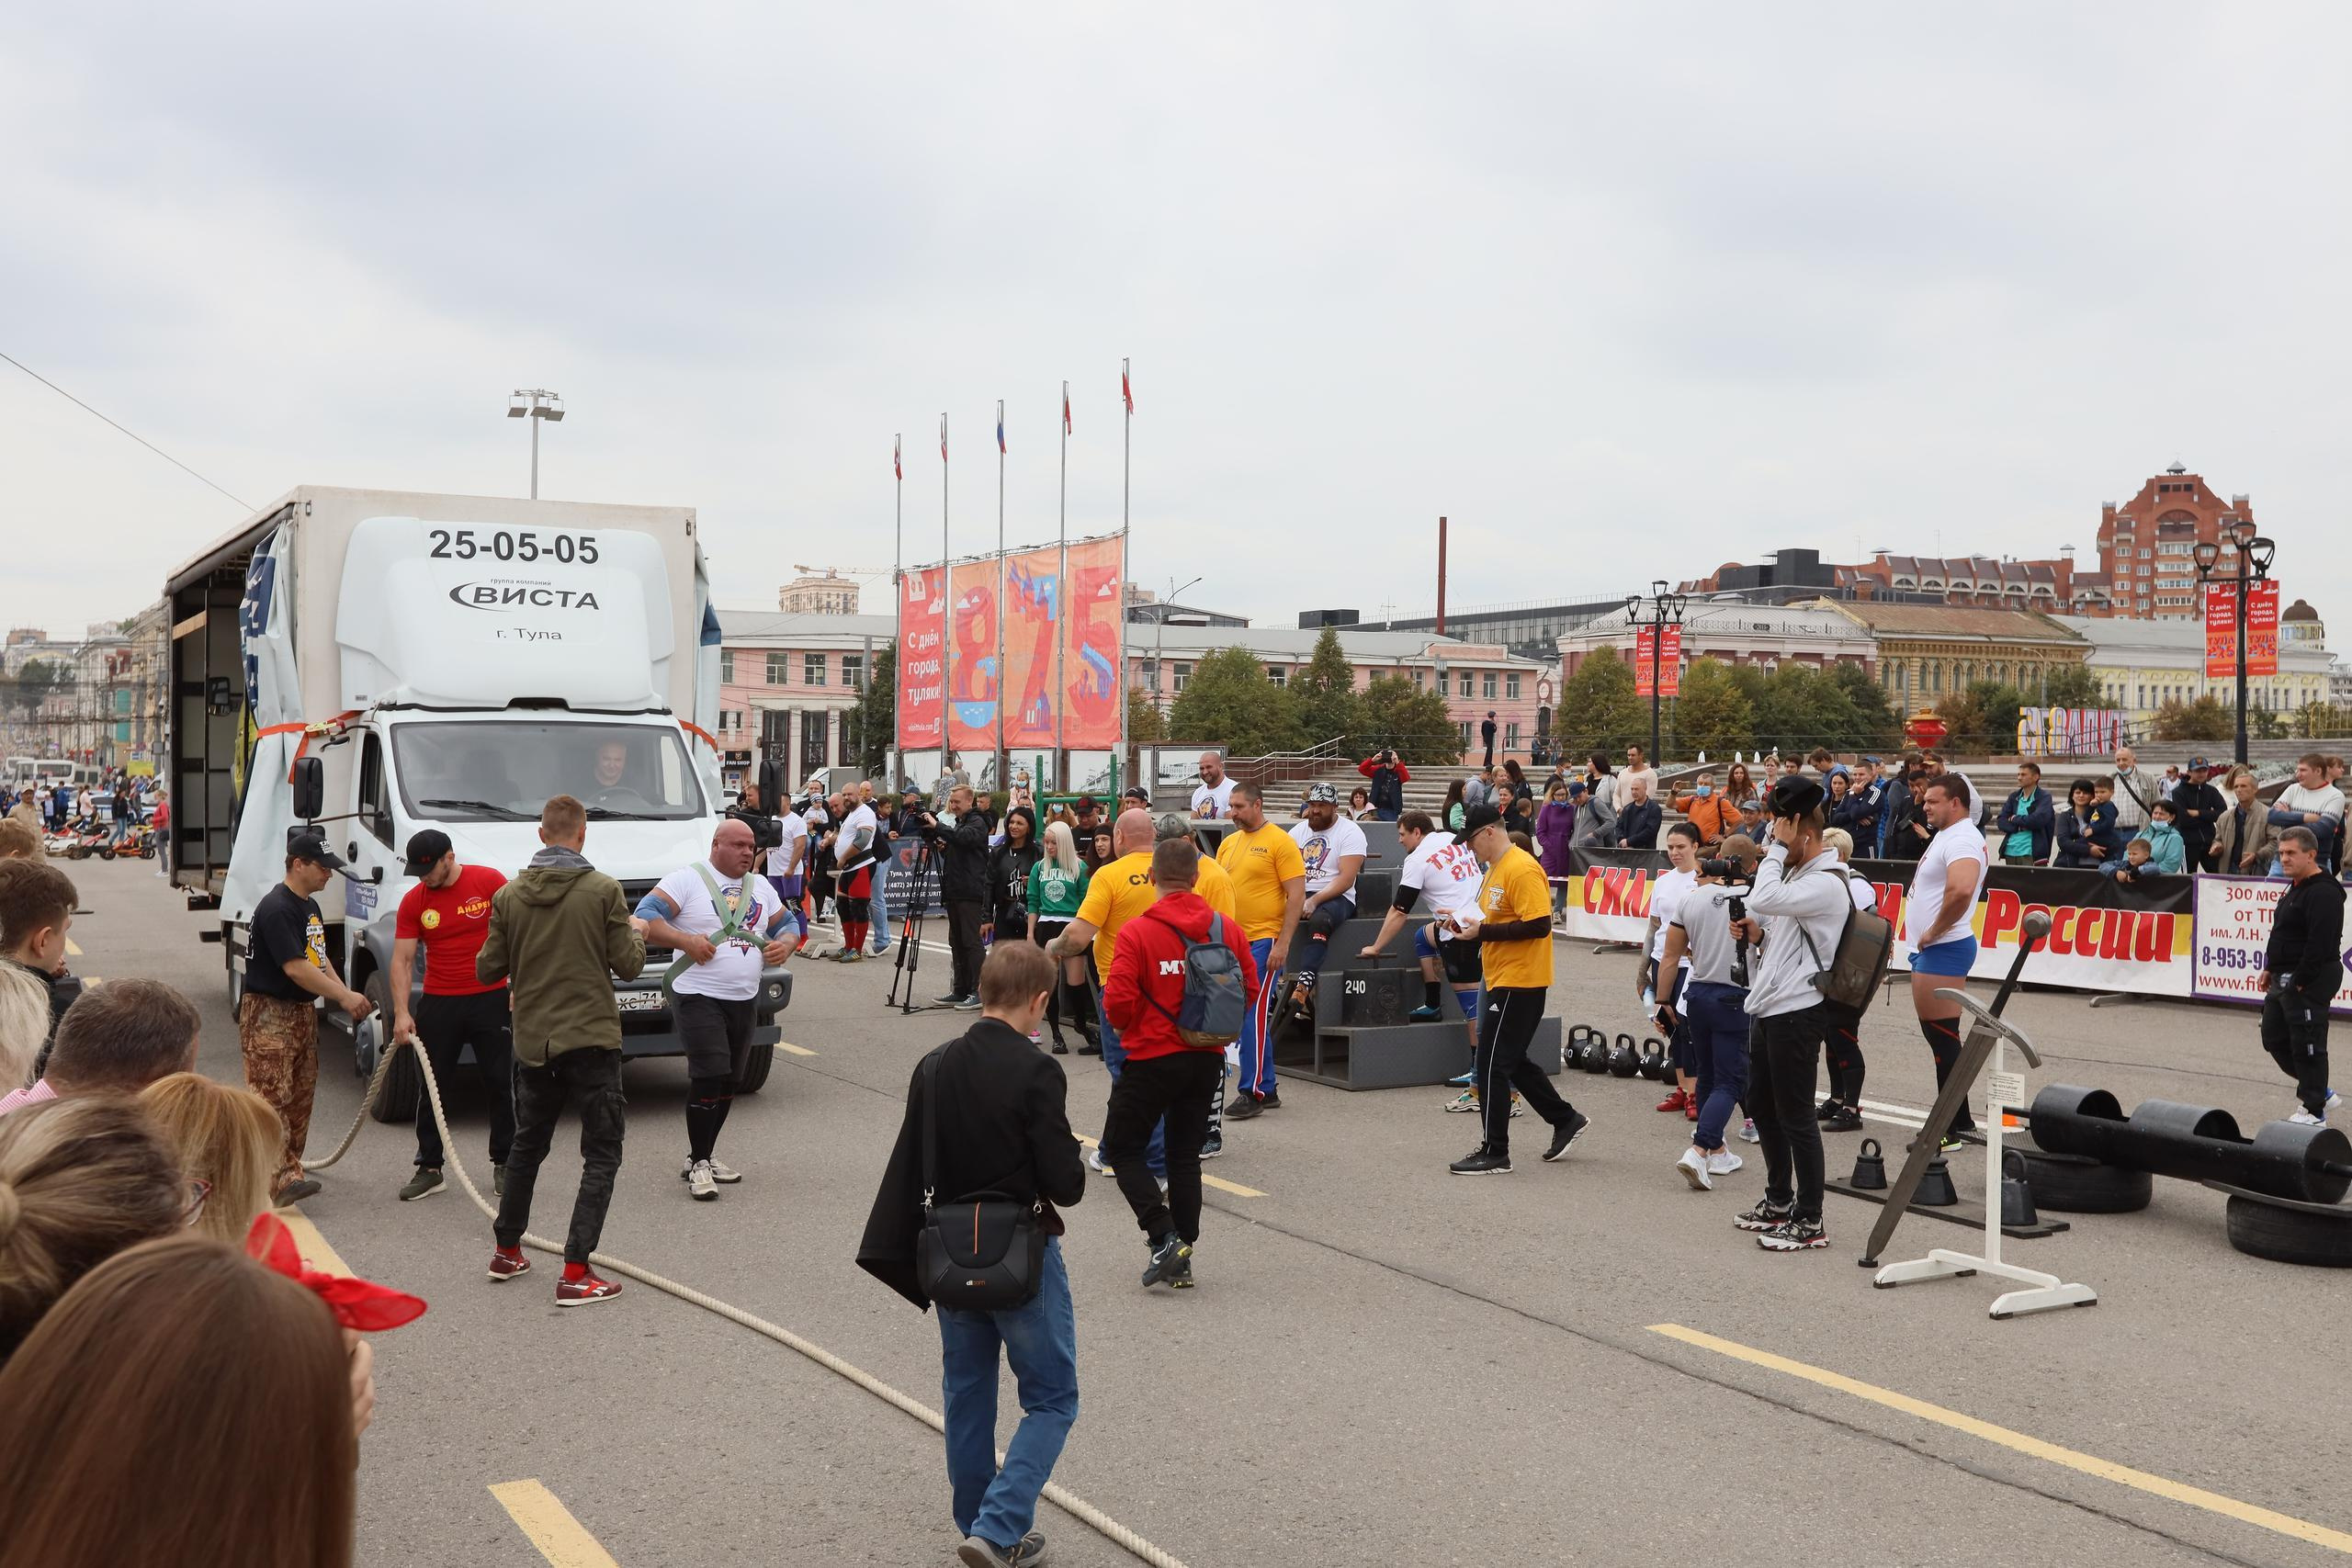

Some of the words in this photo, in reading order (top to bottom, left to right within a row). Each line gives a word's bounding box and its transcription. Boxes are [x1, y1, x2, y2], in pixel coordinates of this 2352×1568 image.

[429, 529, 599, 565] 25-05-05
[491, 578, 514, 586] группа
[472, 586, 600, 610] ВИСТА
[496, 630, 506, 639] г.
[514, 627, 562, 642] Тула
[909, 631, 916, 649] С
[919, 628, 939, 650] днём
[908, 659, 941, 678] города,
[908, 682, 942, 706] туляки!
[1426, 840, 1469, 871] ТУЛ
[1129, 874, 1155, 886] СУ
[2225, 887, 2252, 902] 300
[2234, 909, 2253, 922] от
[2211, 928, 2232, 939] им.
[2235, 928, 2264, 942] Л.Н.
[1345, 980, 1366, 994] 240
